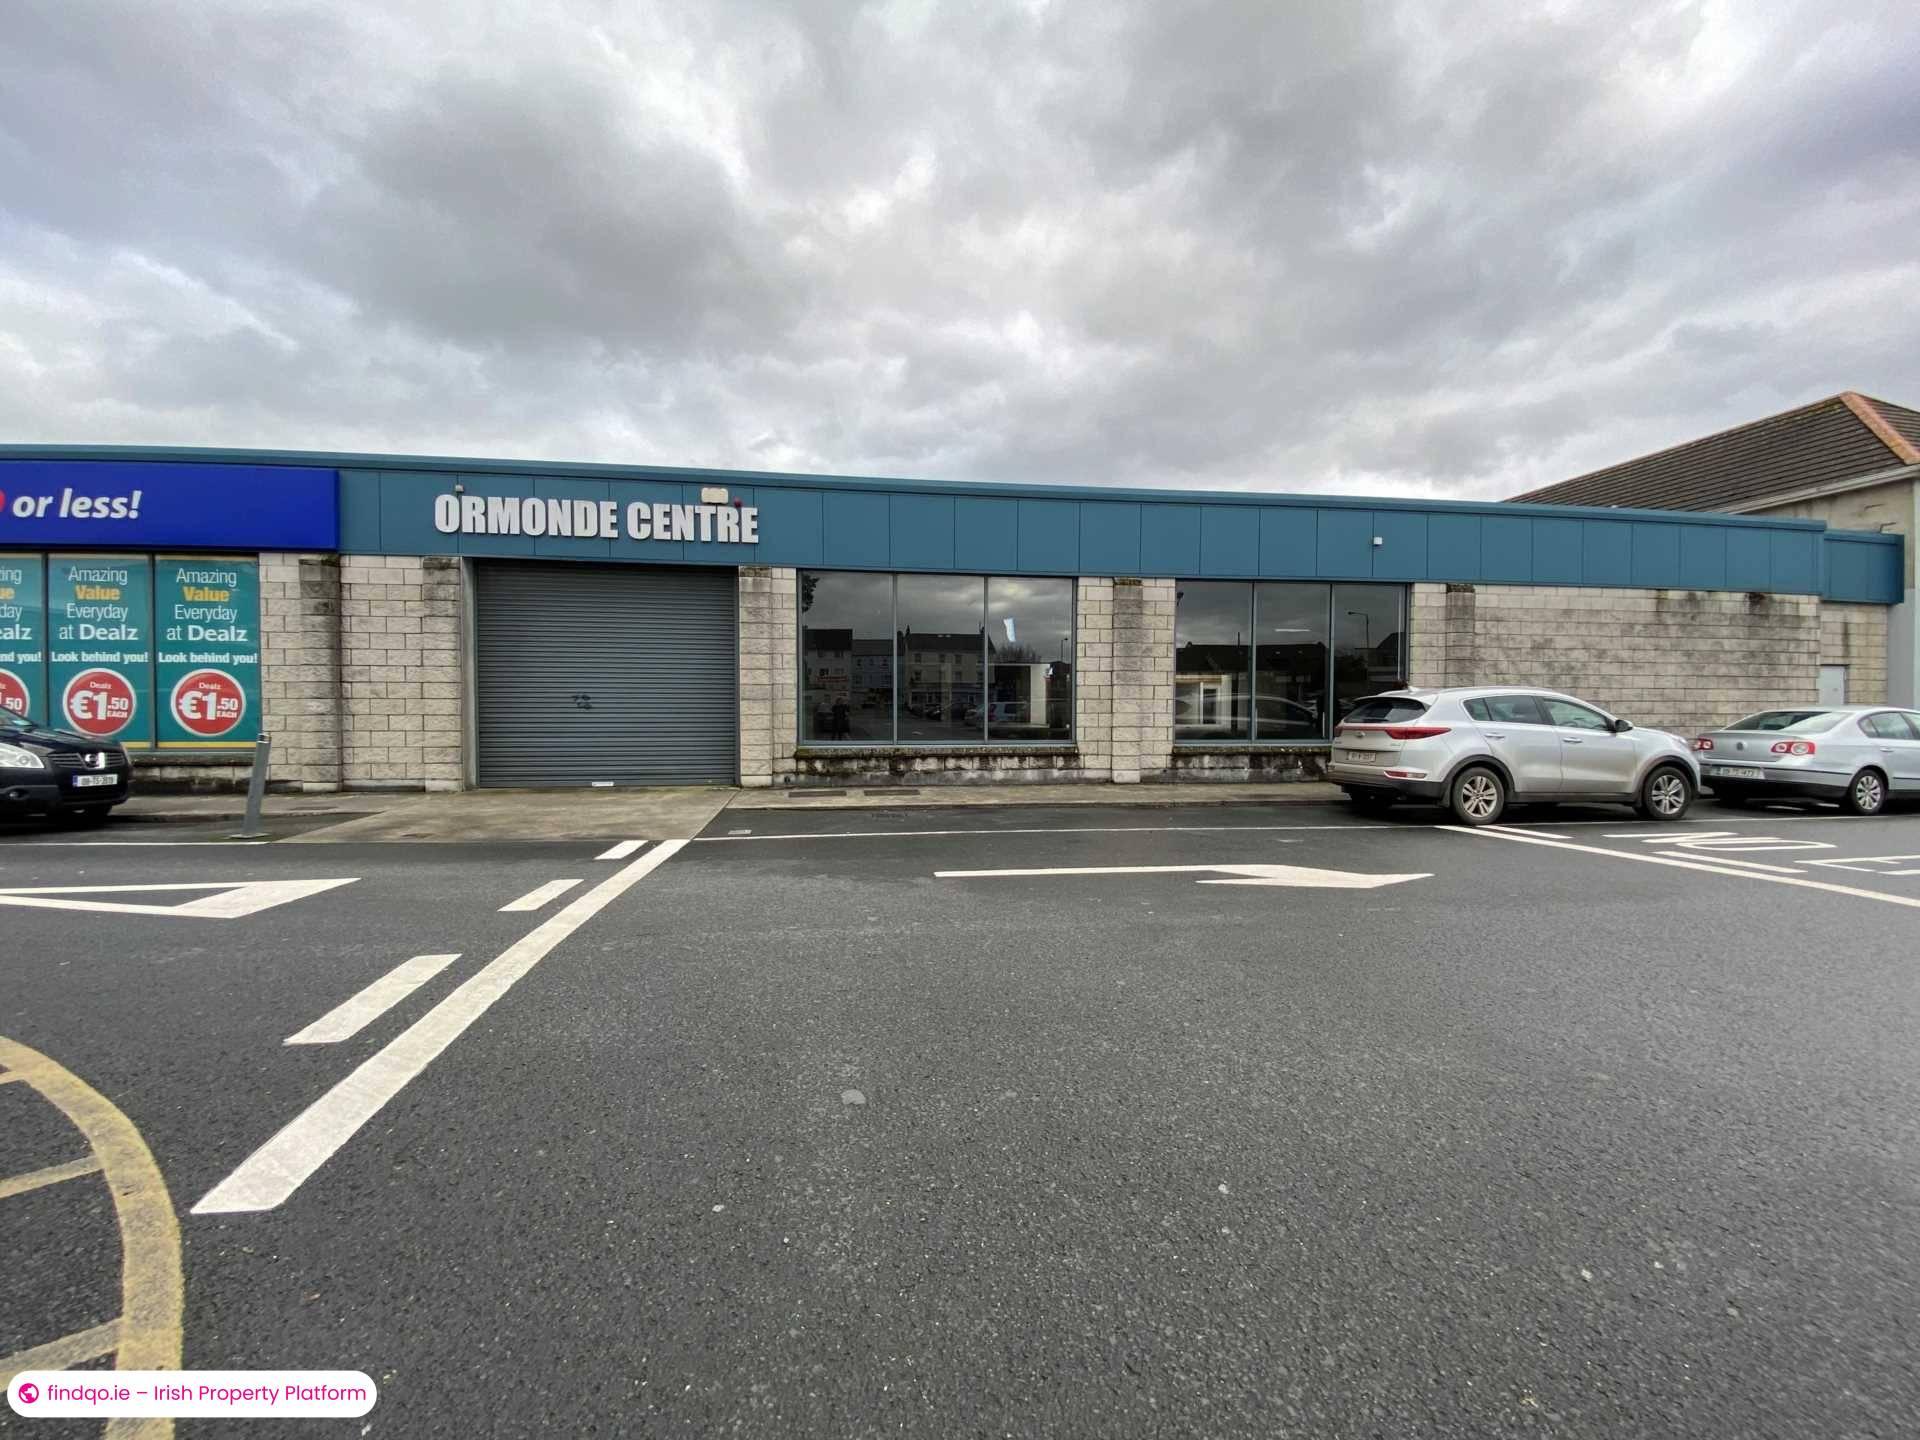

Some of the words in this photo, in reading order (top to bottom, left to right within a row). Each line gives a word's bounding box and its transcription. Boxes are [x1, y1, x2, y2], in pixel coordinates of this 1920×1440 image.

[13, 496, 54, 518] or
[59, 487, 142, 519] less!
[434, 494, 618, 538] ORMONDE
[627, 501, 759, 543] CENTRE
[68, 566, 128, 586] Amazing
[176, 568, 237, 587] Amazing
[75, 585, 120, 600] Value
[183, 587, 230, 602] Value
[66, 603, 128, 622] Everyday
[175, 605, 238, 623] Everyday
[59, 624, 74, 640] at
[79, 624, 138, 640] Dealz
[166, 625, 183, 641] at
[188, 625, 248, 641] Dealz
[18, 652, 41, 664] you!
[52, 651, 78, 662] Look
[81, 651, 120, 662] behind
[123, 652, 148, 665] you!
[159, 652, 186, 662] Look
[190, 652, 229, 663] behind
[232, 654, 257, 665] you!
